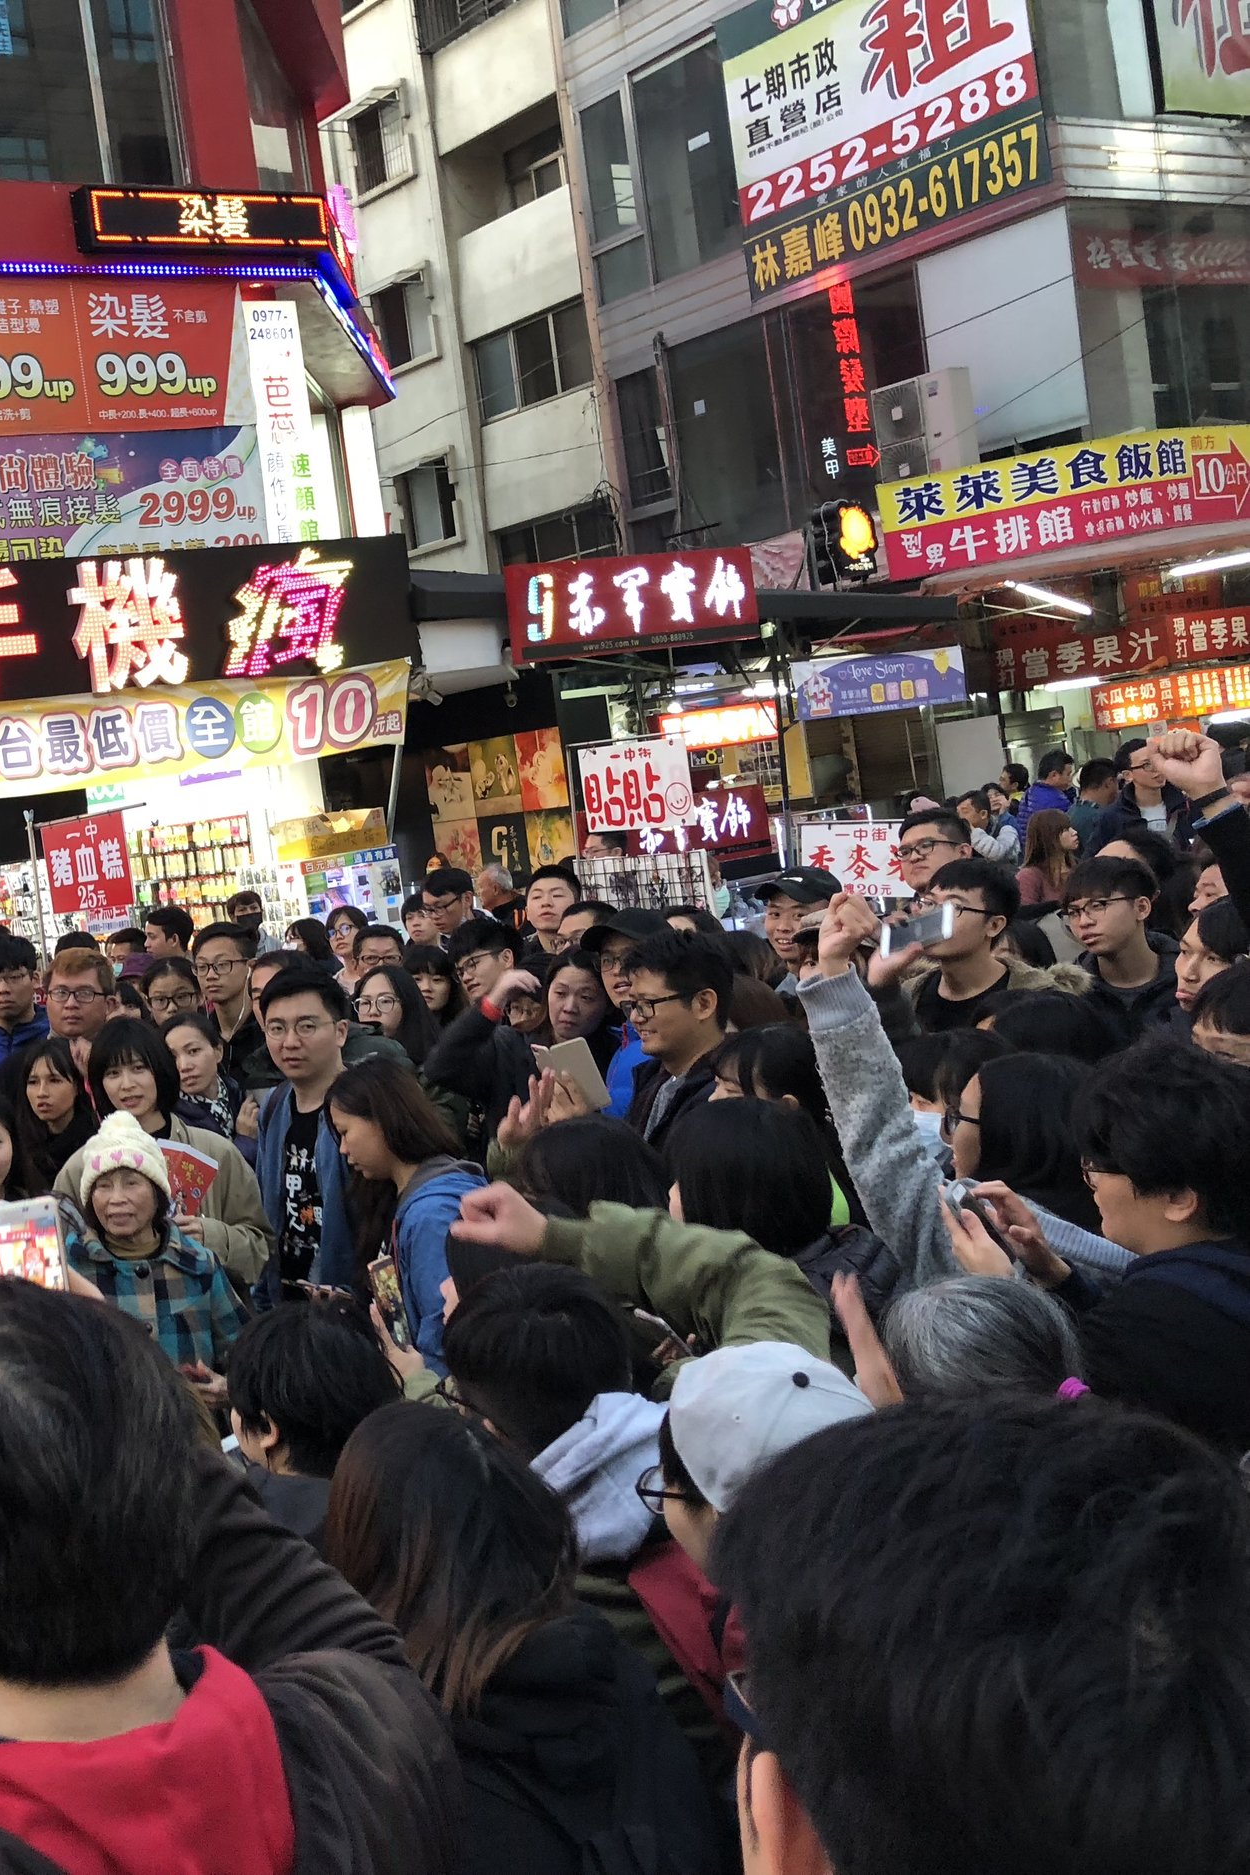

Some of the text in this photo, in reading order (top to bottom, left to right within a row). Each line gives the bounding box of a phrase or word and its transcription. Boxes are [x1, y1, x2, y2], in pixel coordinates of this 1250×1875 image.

[740, 37, 839, 113] 七期市政
[745, 82, 842, 149] 直營店
[747, 61, 1028, 222] 2252-5288
[177, 196, 250, 238] 染髮
[751, 122, 1039, 293] 林嘉峰 0932-617357
[86, 292, 170, 340] 染髮
[252, 309, 288, 322] 0977-
[250, 327, 294, 341] 248601
[1190, 434, 1216, 451] 前方
[160, 455, 244, 482] 全面特價
[895, 437, 1188, 526] 萊萊美食飯館
[1021, 627, 1160, 680] 當季果汁
[847, 661, 906, 683] Love Story
[1094, 682, 1157, 708] 木瓜牛奶
[610, 747, 652, 763] 一中街
[584, 762, 666, 831] 貼貼
[65, 822, 99, 844] 一中
[835, 828, 888, 842] 一中街
[49, 837, 126, 888] 豬血糕
[77, 884, 108, 910] 25元
